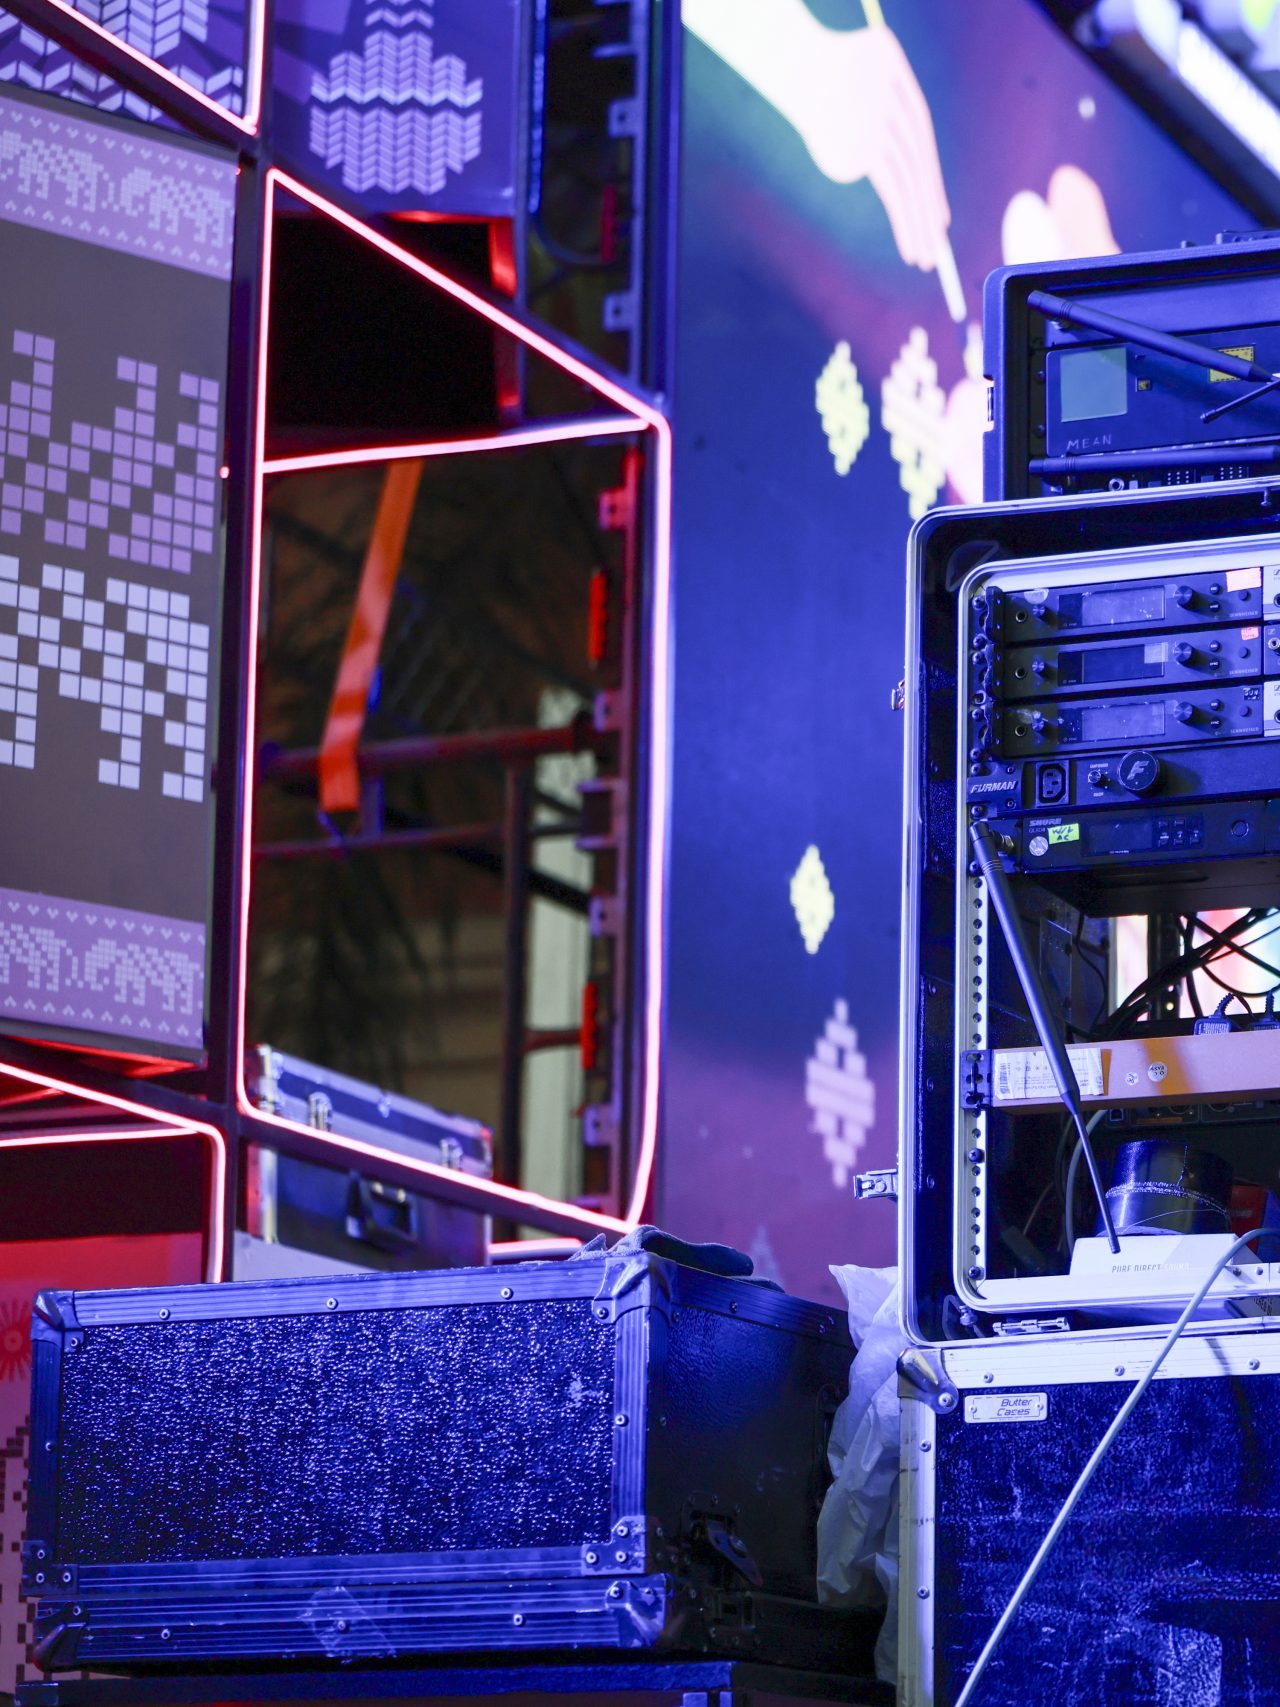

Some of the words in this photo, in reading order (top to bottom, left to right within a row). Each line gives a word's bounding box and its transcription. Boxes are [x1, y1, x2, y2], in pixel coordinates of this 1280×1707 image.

[1066, 433, 1112, 450] MEAN
[970, 781, 1016, 794] FURMAN
[1029, 817, 1062, 827] SHURE
[1134, 1264, 1161, 1272] DIRECT
[1001, 1398, 1033, 1407] Butter
[997, 1408, 1031, 1417] Cases
